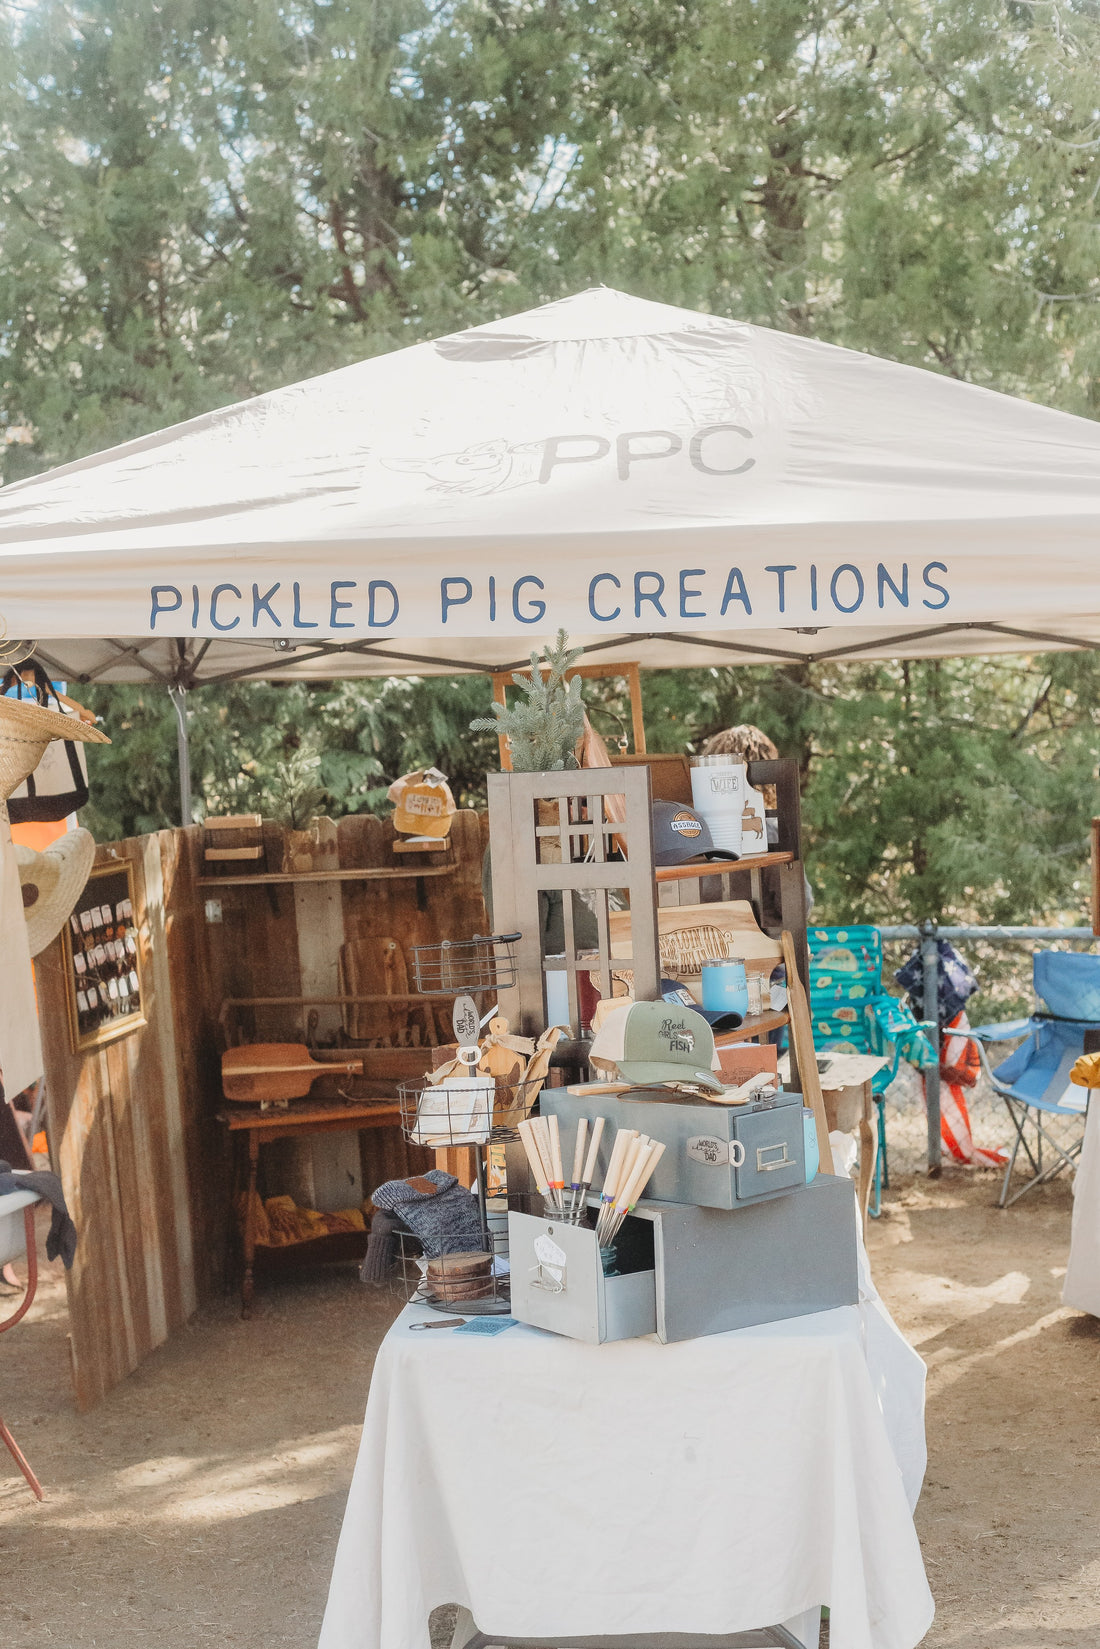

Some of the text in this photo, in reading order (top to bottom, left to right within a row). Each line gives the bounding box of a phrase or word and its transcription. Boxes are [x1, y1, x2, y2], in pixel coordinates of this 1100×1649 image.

[537, 424, 756, 485] PPC
[150, 561, 950, 631] PICKLED PIG CREATIONS
[712, 778, 737, 791] WIFE
[674, 928, 702, 951] LOIN
[456, 1019, 465, 1034] DAD
[661, 1018, 687, 1031] Reel
[669, 1040, 690, 1053] FISH
[704, 1152, 717, 1162] DAD
